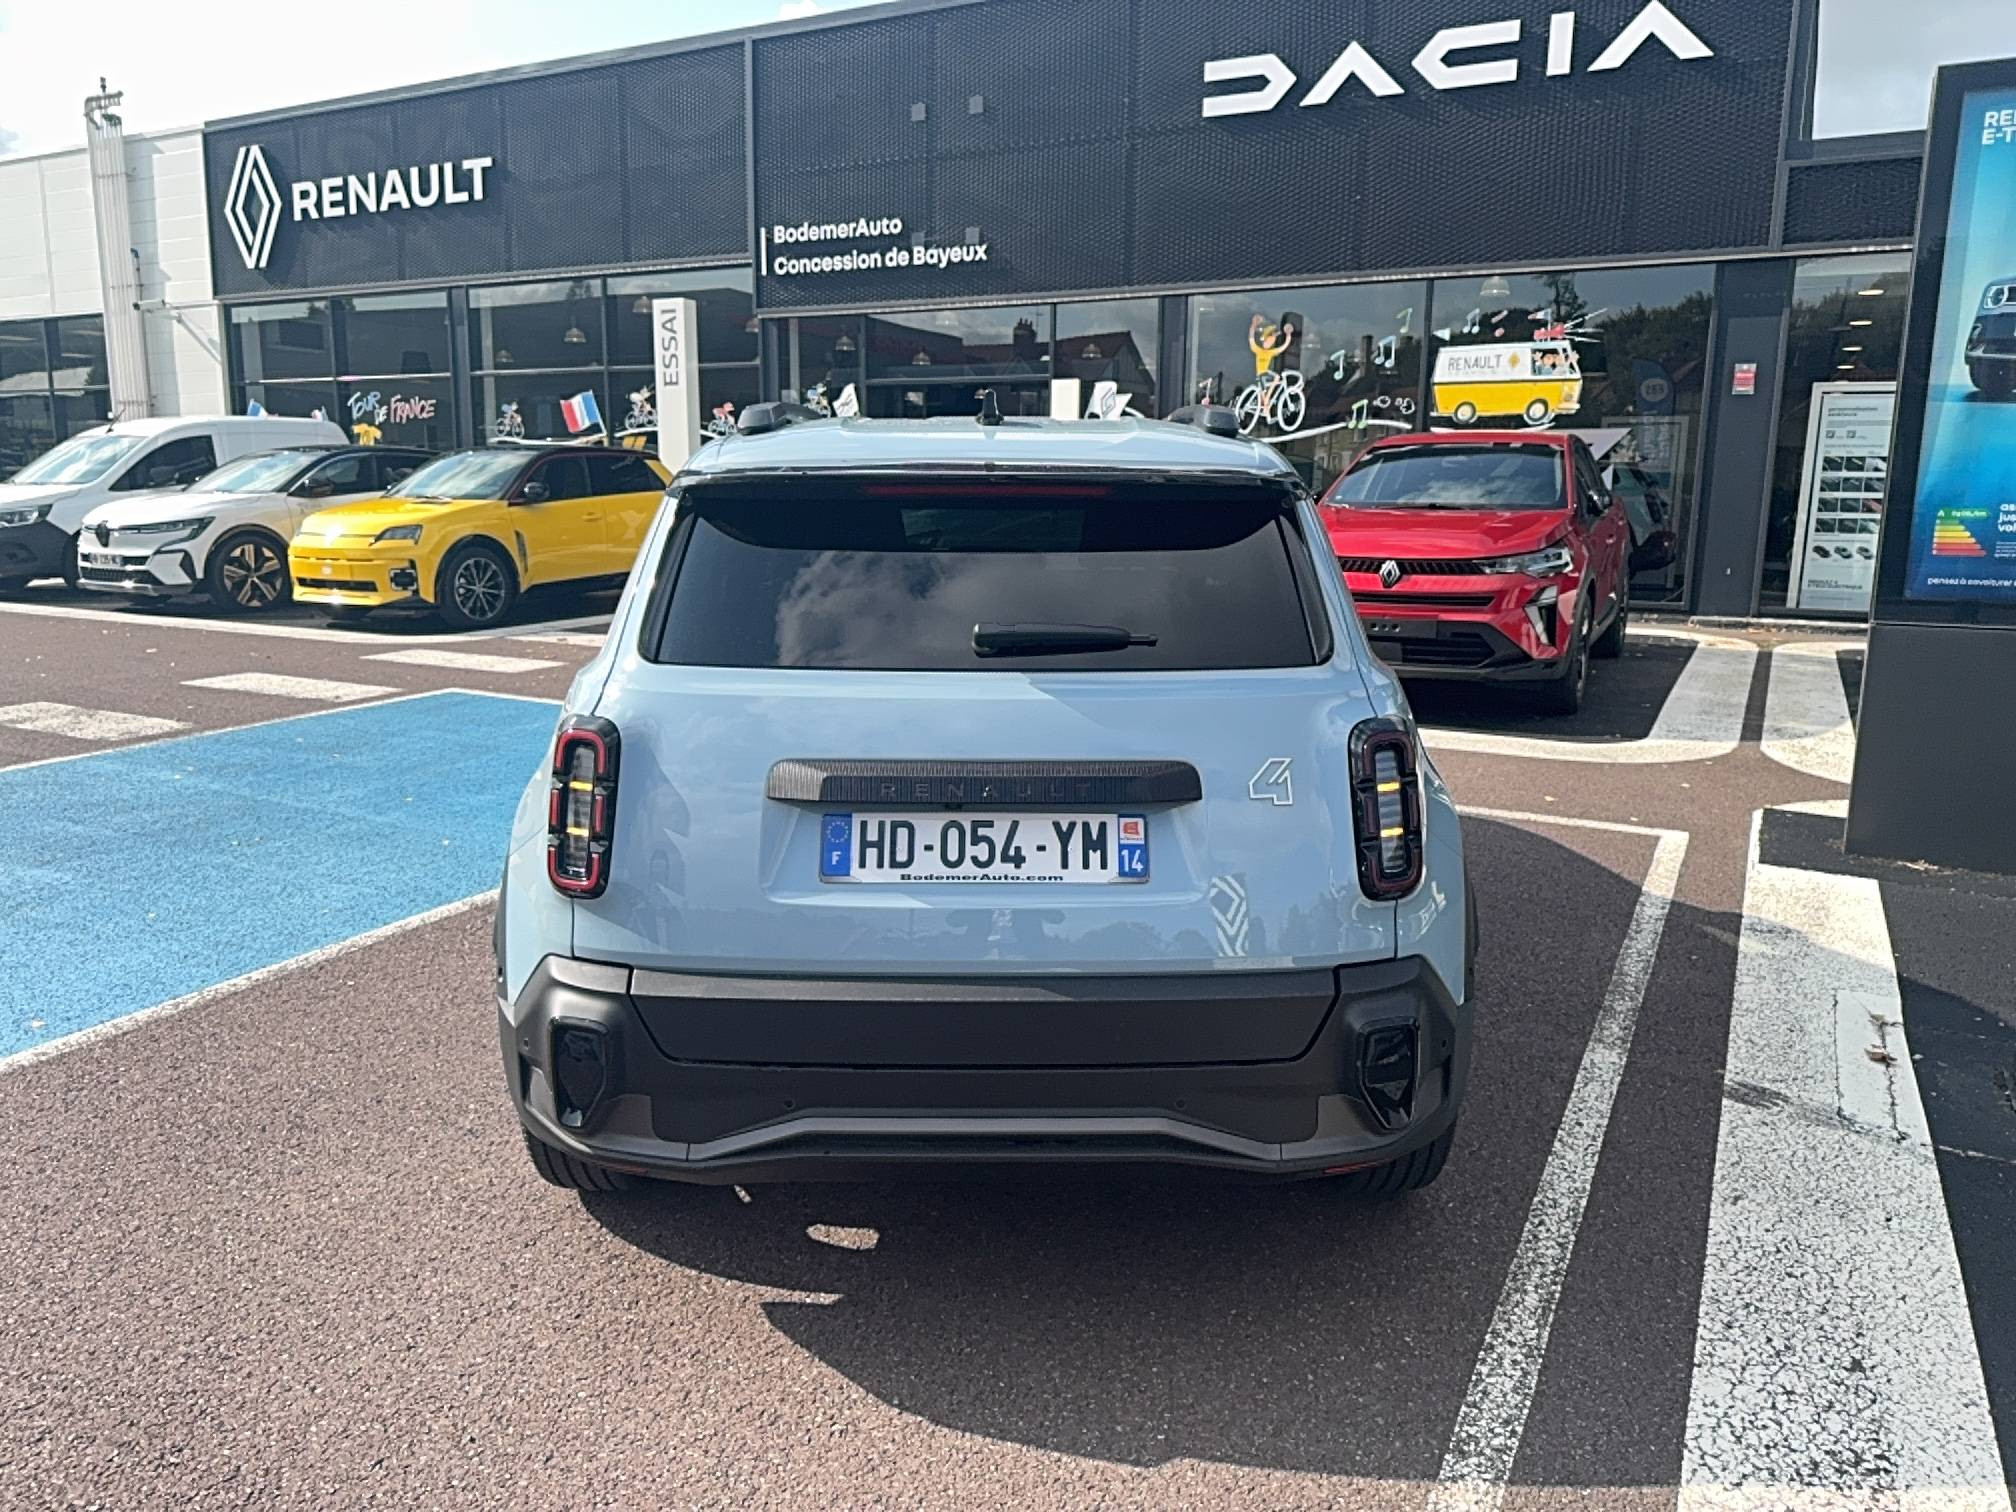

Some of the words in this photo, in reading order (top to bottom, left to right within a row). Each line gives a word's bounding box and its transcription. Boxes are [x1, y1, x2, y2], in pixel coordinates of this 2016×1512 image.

[1202, 0, 1714, 118] DACIA
[1984, 109, 2016, 126] RE
[291, 156, 493, 222] RENAULT
[773, 217, 902, 244] BodemerAuto
[773, 249, 882, 276] Concession
[884, 246, 909, 268] de
[913, 244, 988, 269] Bayeux
[661, 308, 679, 387] ESSAI
[1448, 353, 1503, 371] RENAULT
[390, 393, 437, 425] FRANCE
[880, 782, 1089, 798] RENAULT
[831, 851, 842, 865] F
[858, 819, 1108, 870] HD-054-YM
[1121, 849, 1143, 872] 14
[901, 873, 1064, 882] BodemerAuto.com
